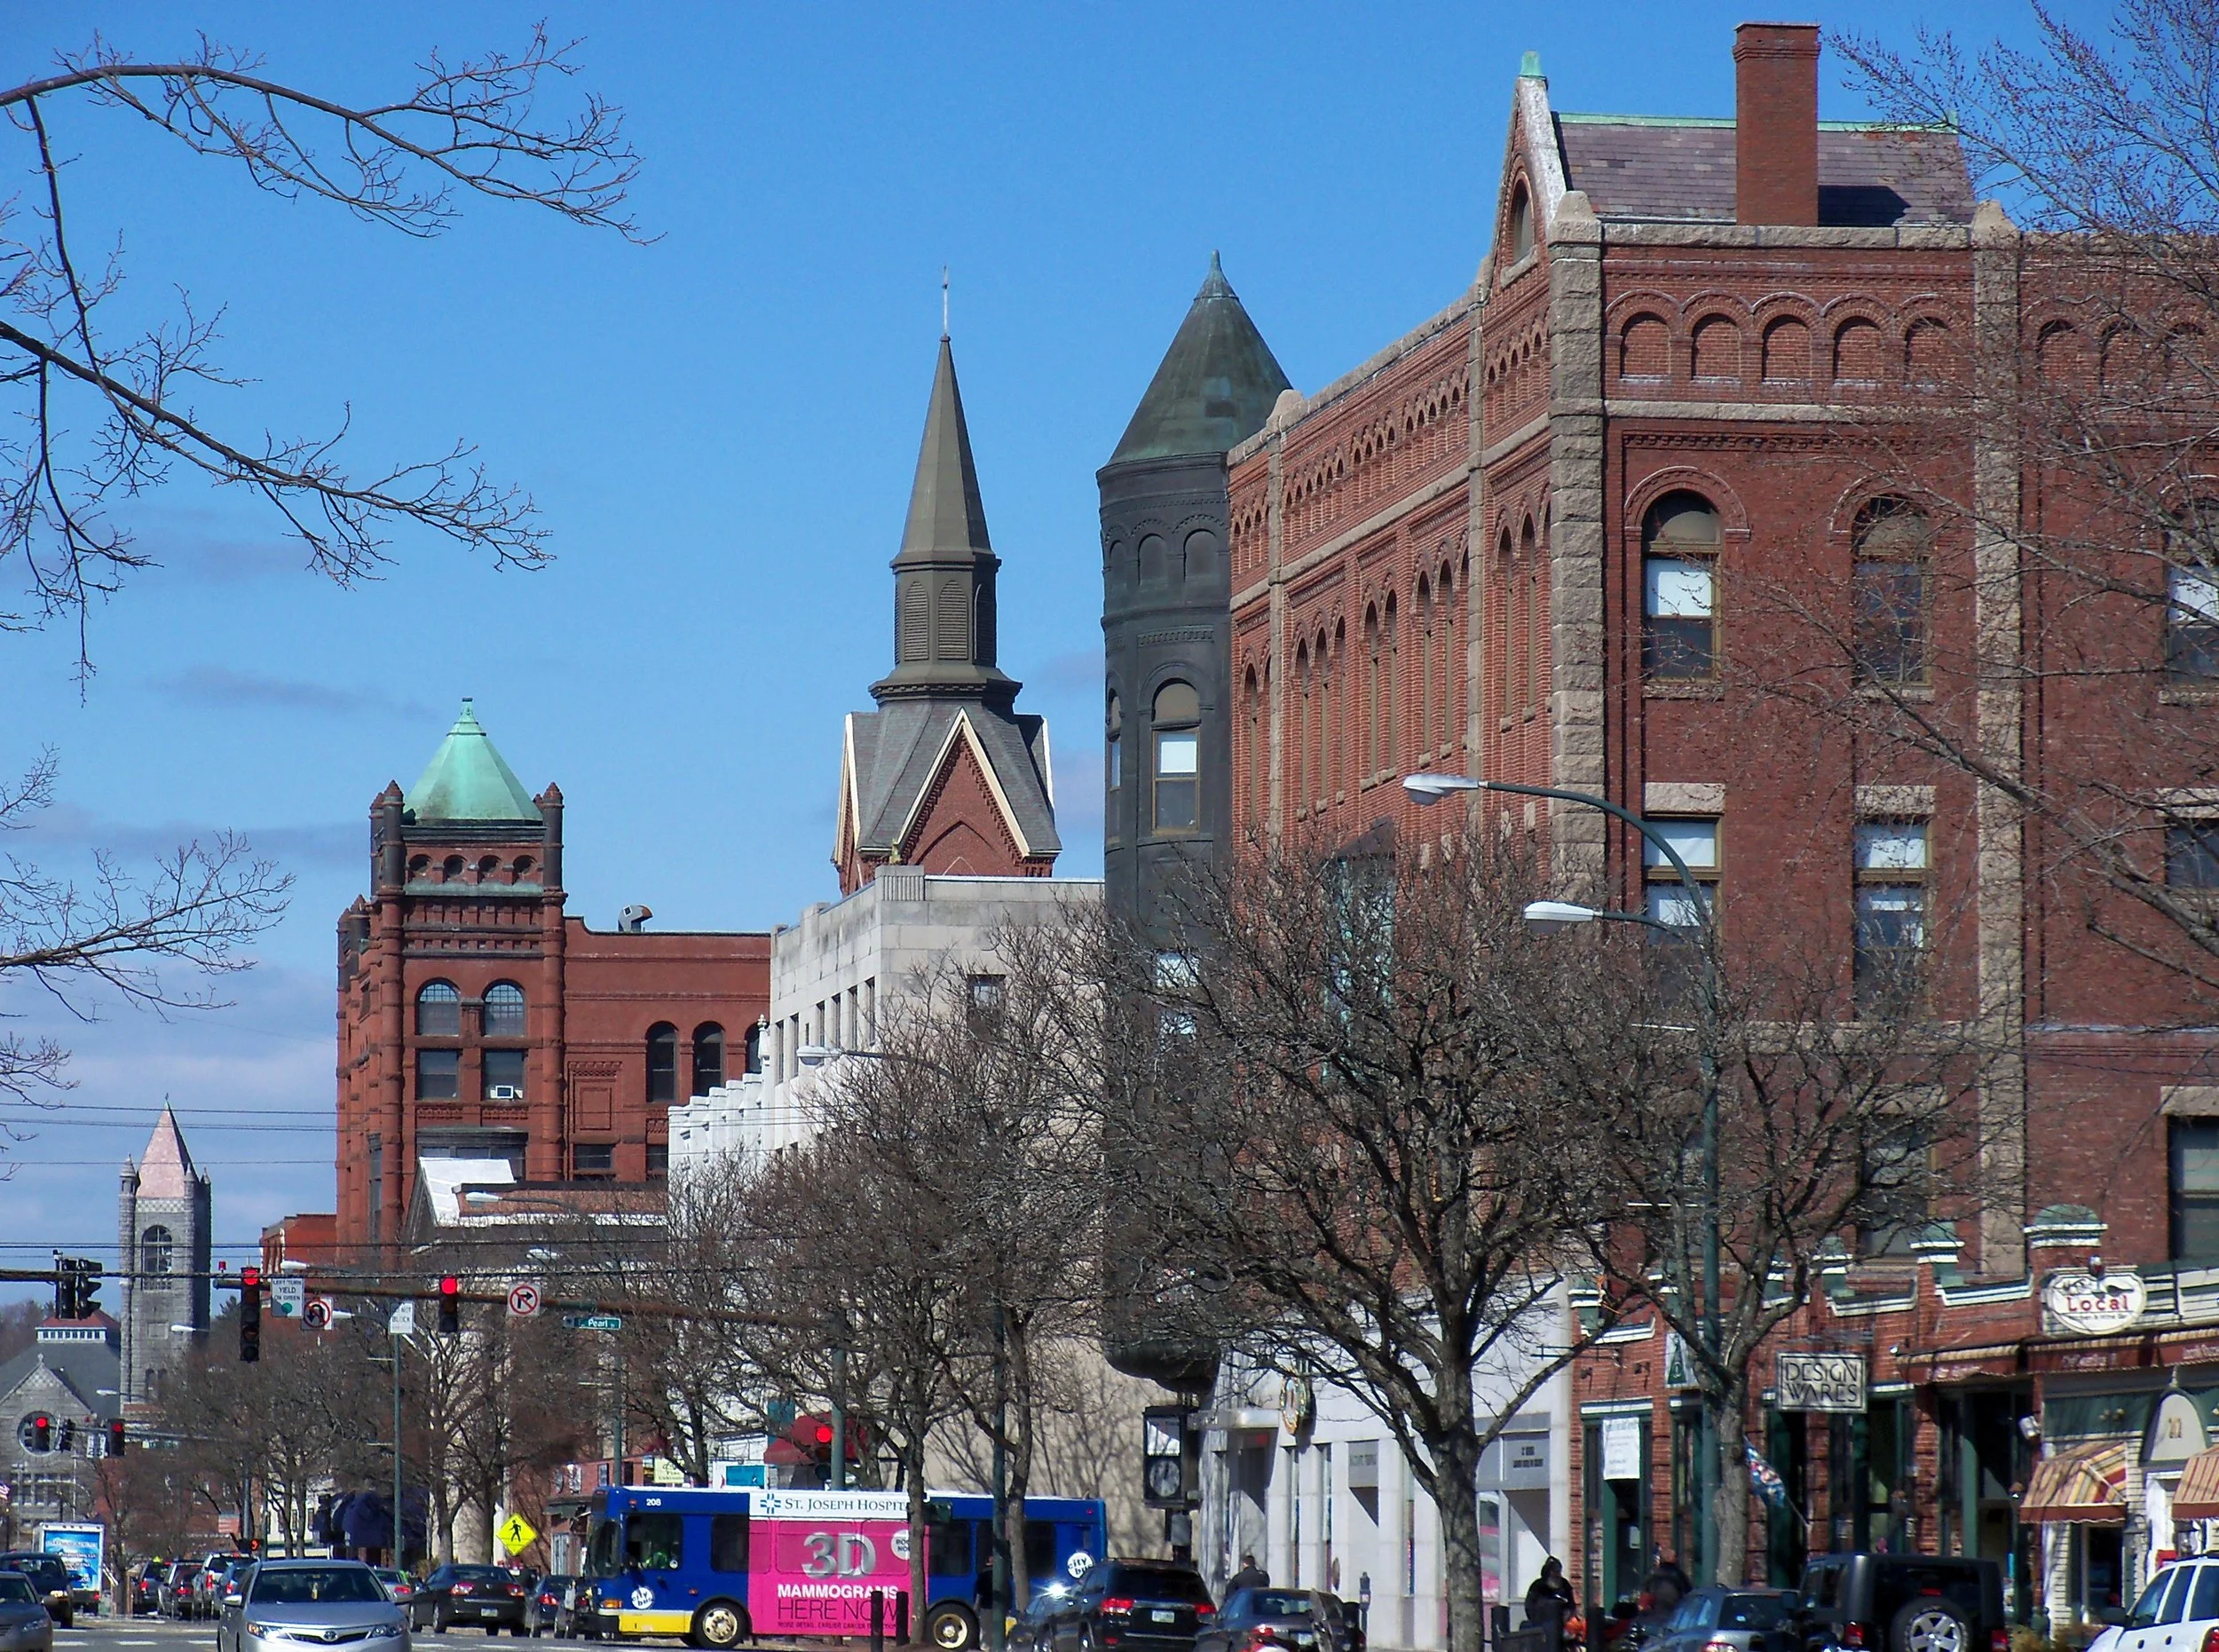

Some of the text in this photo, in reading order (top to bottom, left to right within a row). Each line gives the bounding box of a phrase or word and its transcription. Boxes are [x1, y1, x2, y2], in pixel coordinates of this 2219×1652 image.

[2066, 1295, 2128, 1311] Local
[588, 1318, 608, 1327] Pearl
[1785, 1359, 1858, 1382] DESIGN
[1785, 1383, 1858, 1403] WARES
[646, 1498, 661, 1506] 208
[785, 1498, 906, 1512] ST. JOSEPH HOSPIT
[802, 1532, 876, 1580] 3D
[778, 1584, 898, 1600] MAMMOGRAMS
[778, 1600, 837, 1620] HERE
